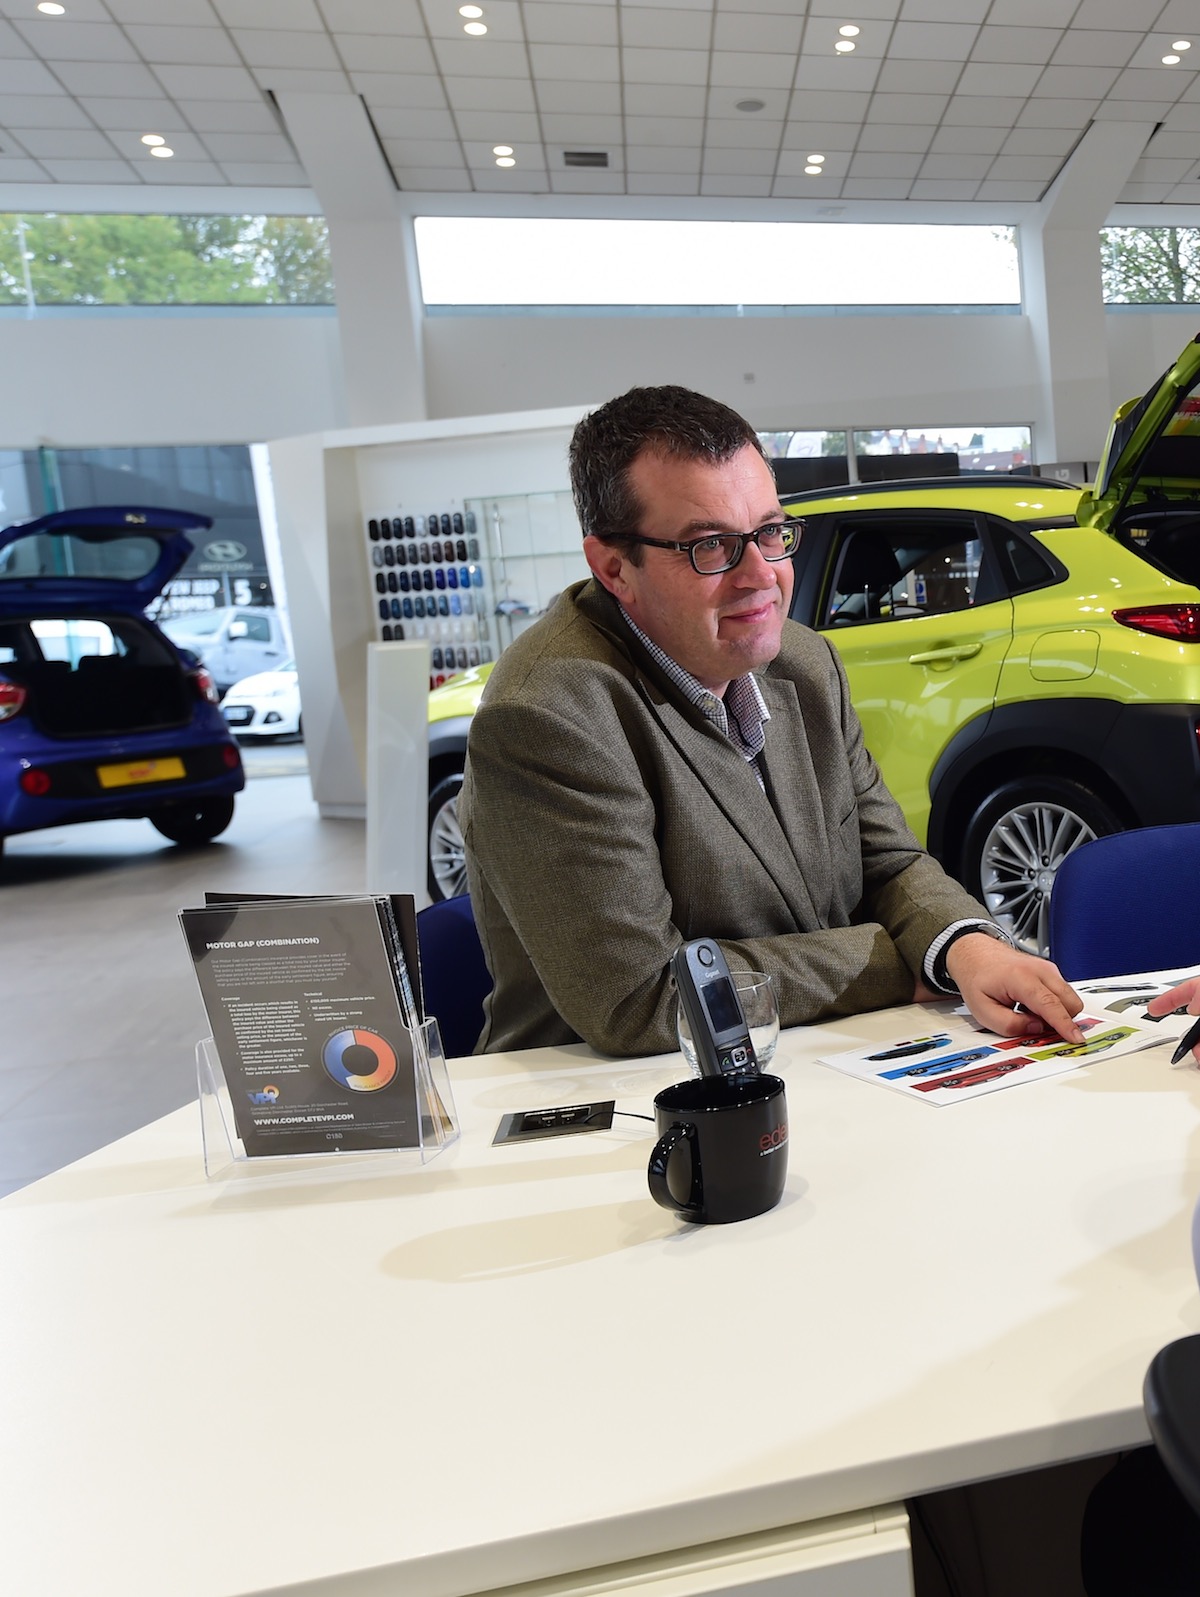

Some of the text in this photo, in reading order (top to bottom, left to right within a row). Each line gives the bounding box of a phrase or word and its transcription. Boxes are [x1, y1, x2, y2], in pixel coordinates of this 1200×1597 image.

[206, 937, 320, 950] MOTOR GAP (COMBINATION)
[254, 1113, 355, 1126] WWW.COMPLETEVPI.COM
[759, 1123, 788, 1151] ede
